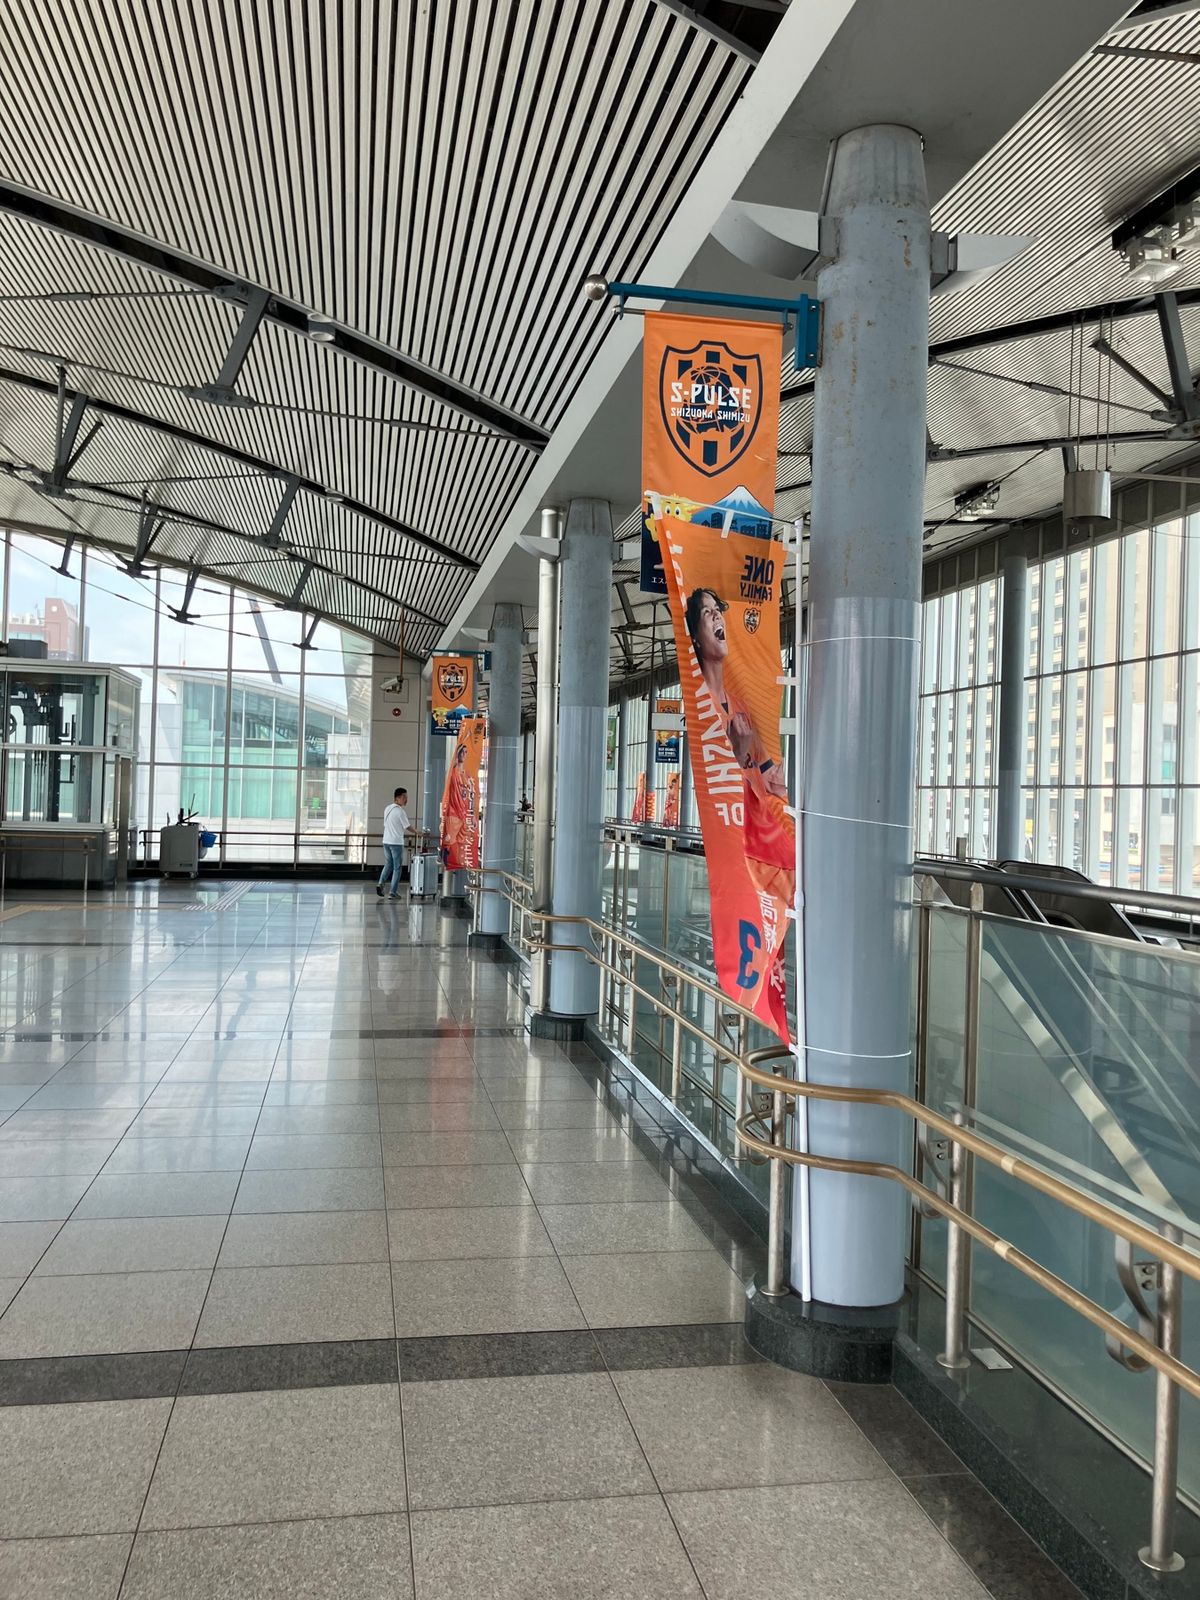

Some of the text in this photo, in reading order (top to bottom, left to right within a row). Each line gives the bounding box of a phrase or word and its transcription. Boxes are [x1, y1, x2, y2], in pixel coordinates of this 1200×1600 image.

[670, 381, 752, 409] S-PULSE
[671, 407, 751, 423] SHIZUOKA SHIMIZU
